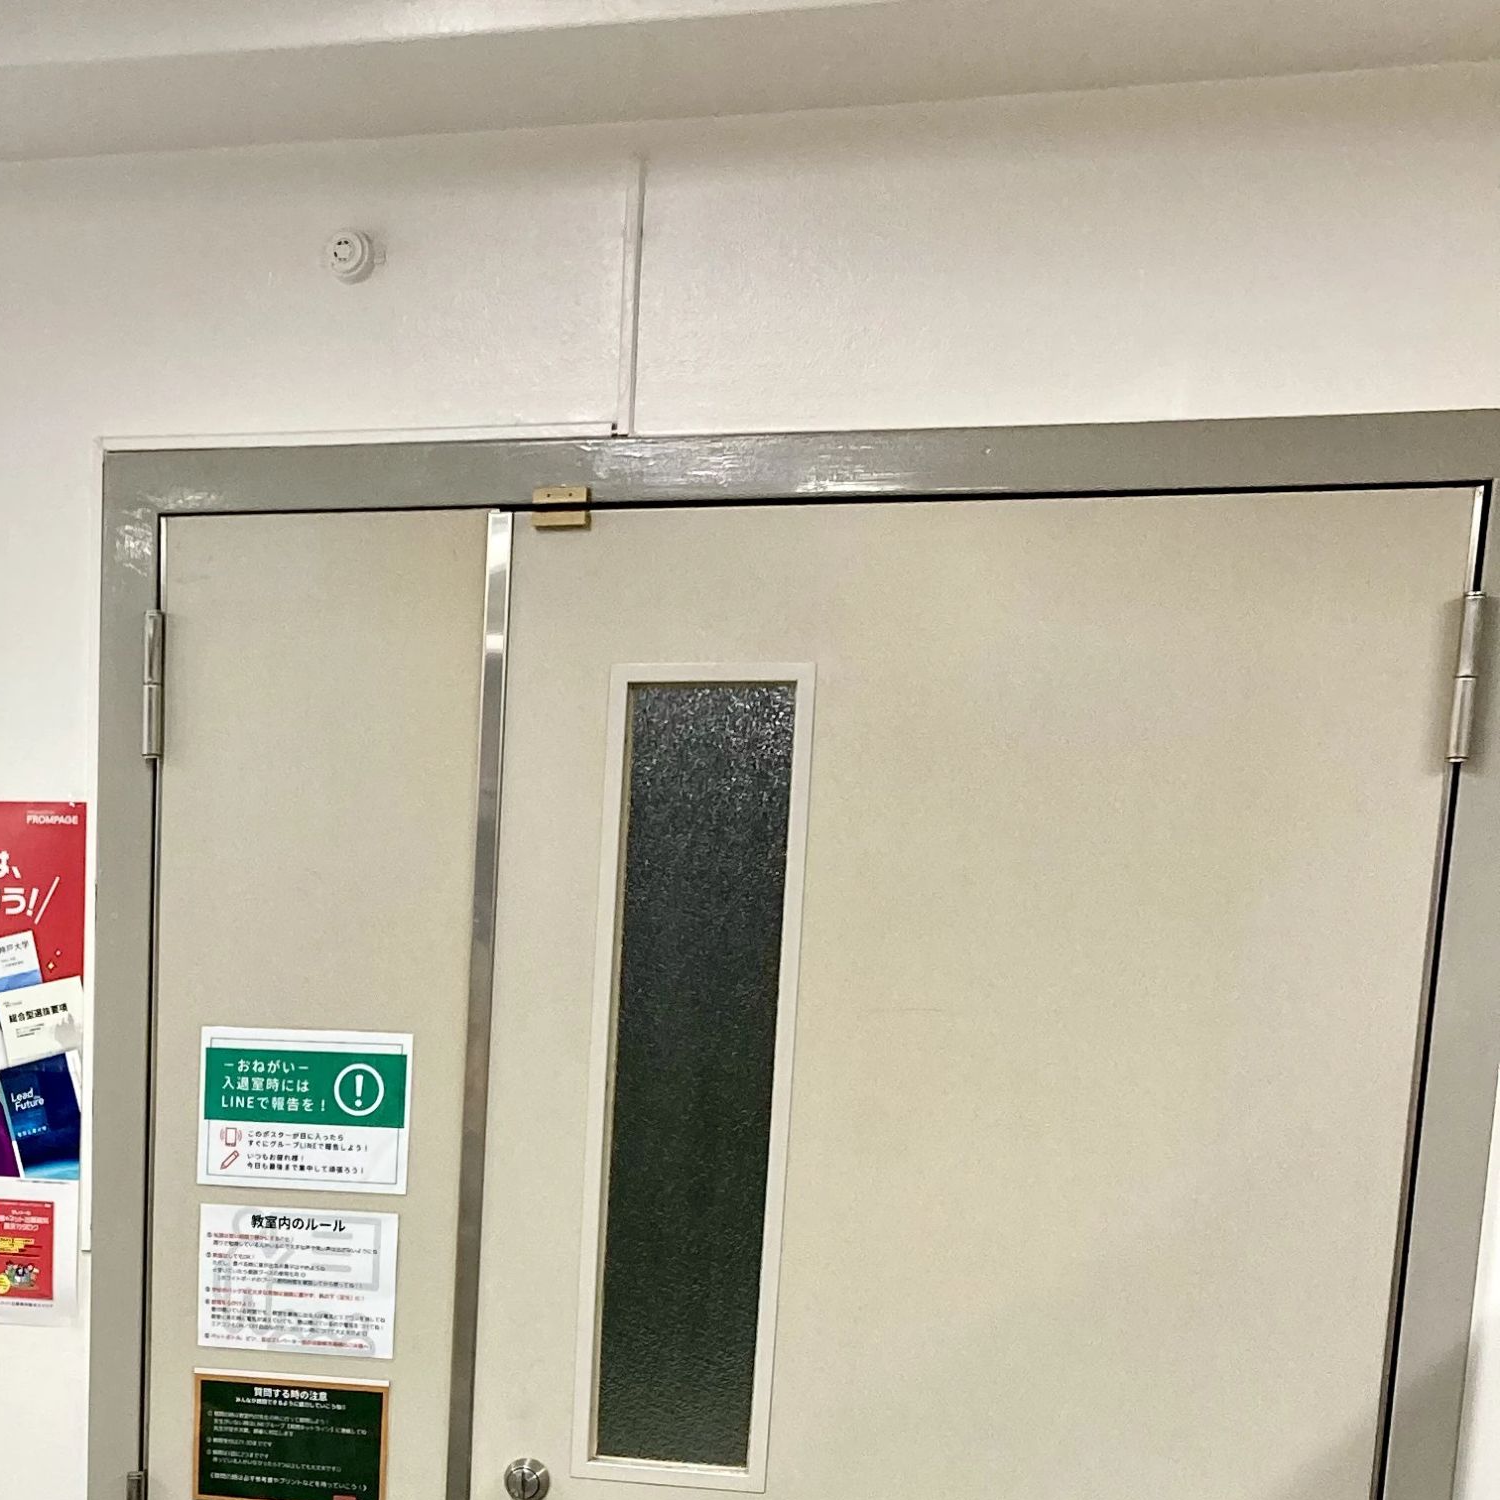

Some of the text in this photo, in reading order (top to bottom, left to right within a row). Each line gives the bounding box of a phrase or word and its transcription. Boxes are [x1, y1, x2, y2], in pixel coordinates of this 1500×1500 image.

[27, 814, 78, 825] FROMPAGE
[222, 1075, 310, 1092] 入退室時には
[11, 1087, 34, 1103] Lead
[15, 1098, 45, 1112] Future
[221, 1096, 326, 1112] LINEで報告を！
[247, 1130, 344, 1142] このポスターが目に入ったら
[251, 1214, 346, 1233] 教室内のルール
[253, 1386, 329, 1402] 質問する時の注意
